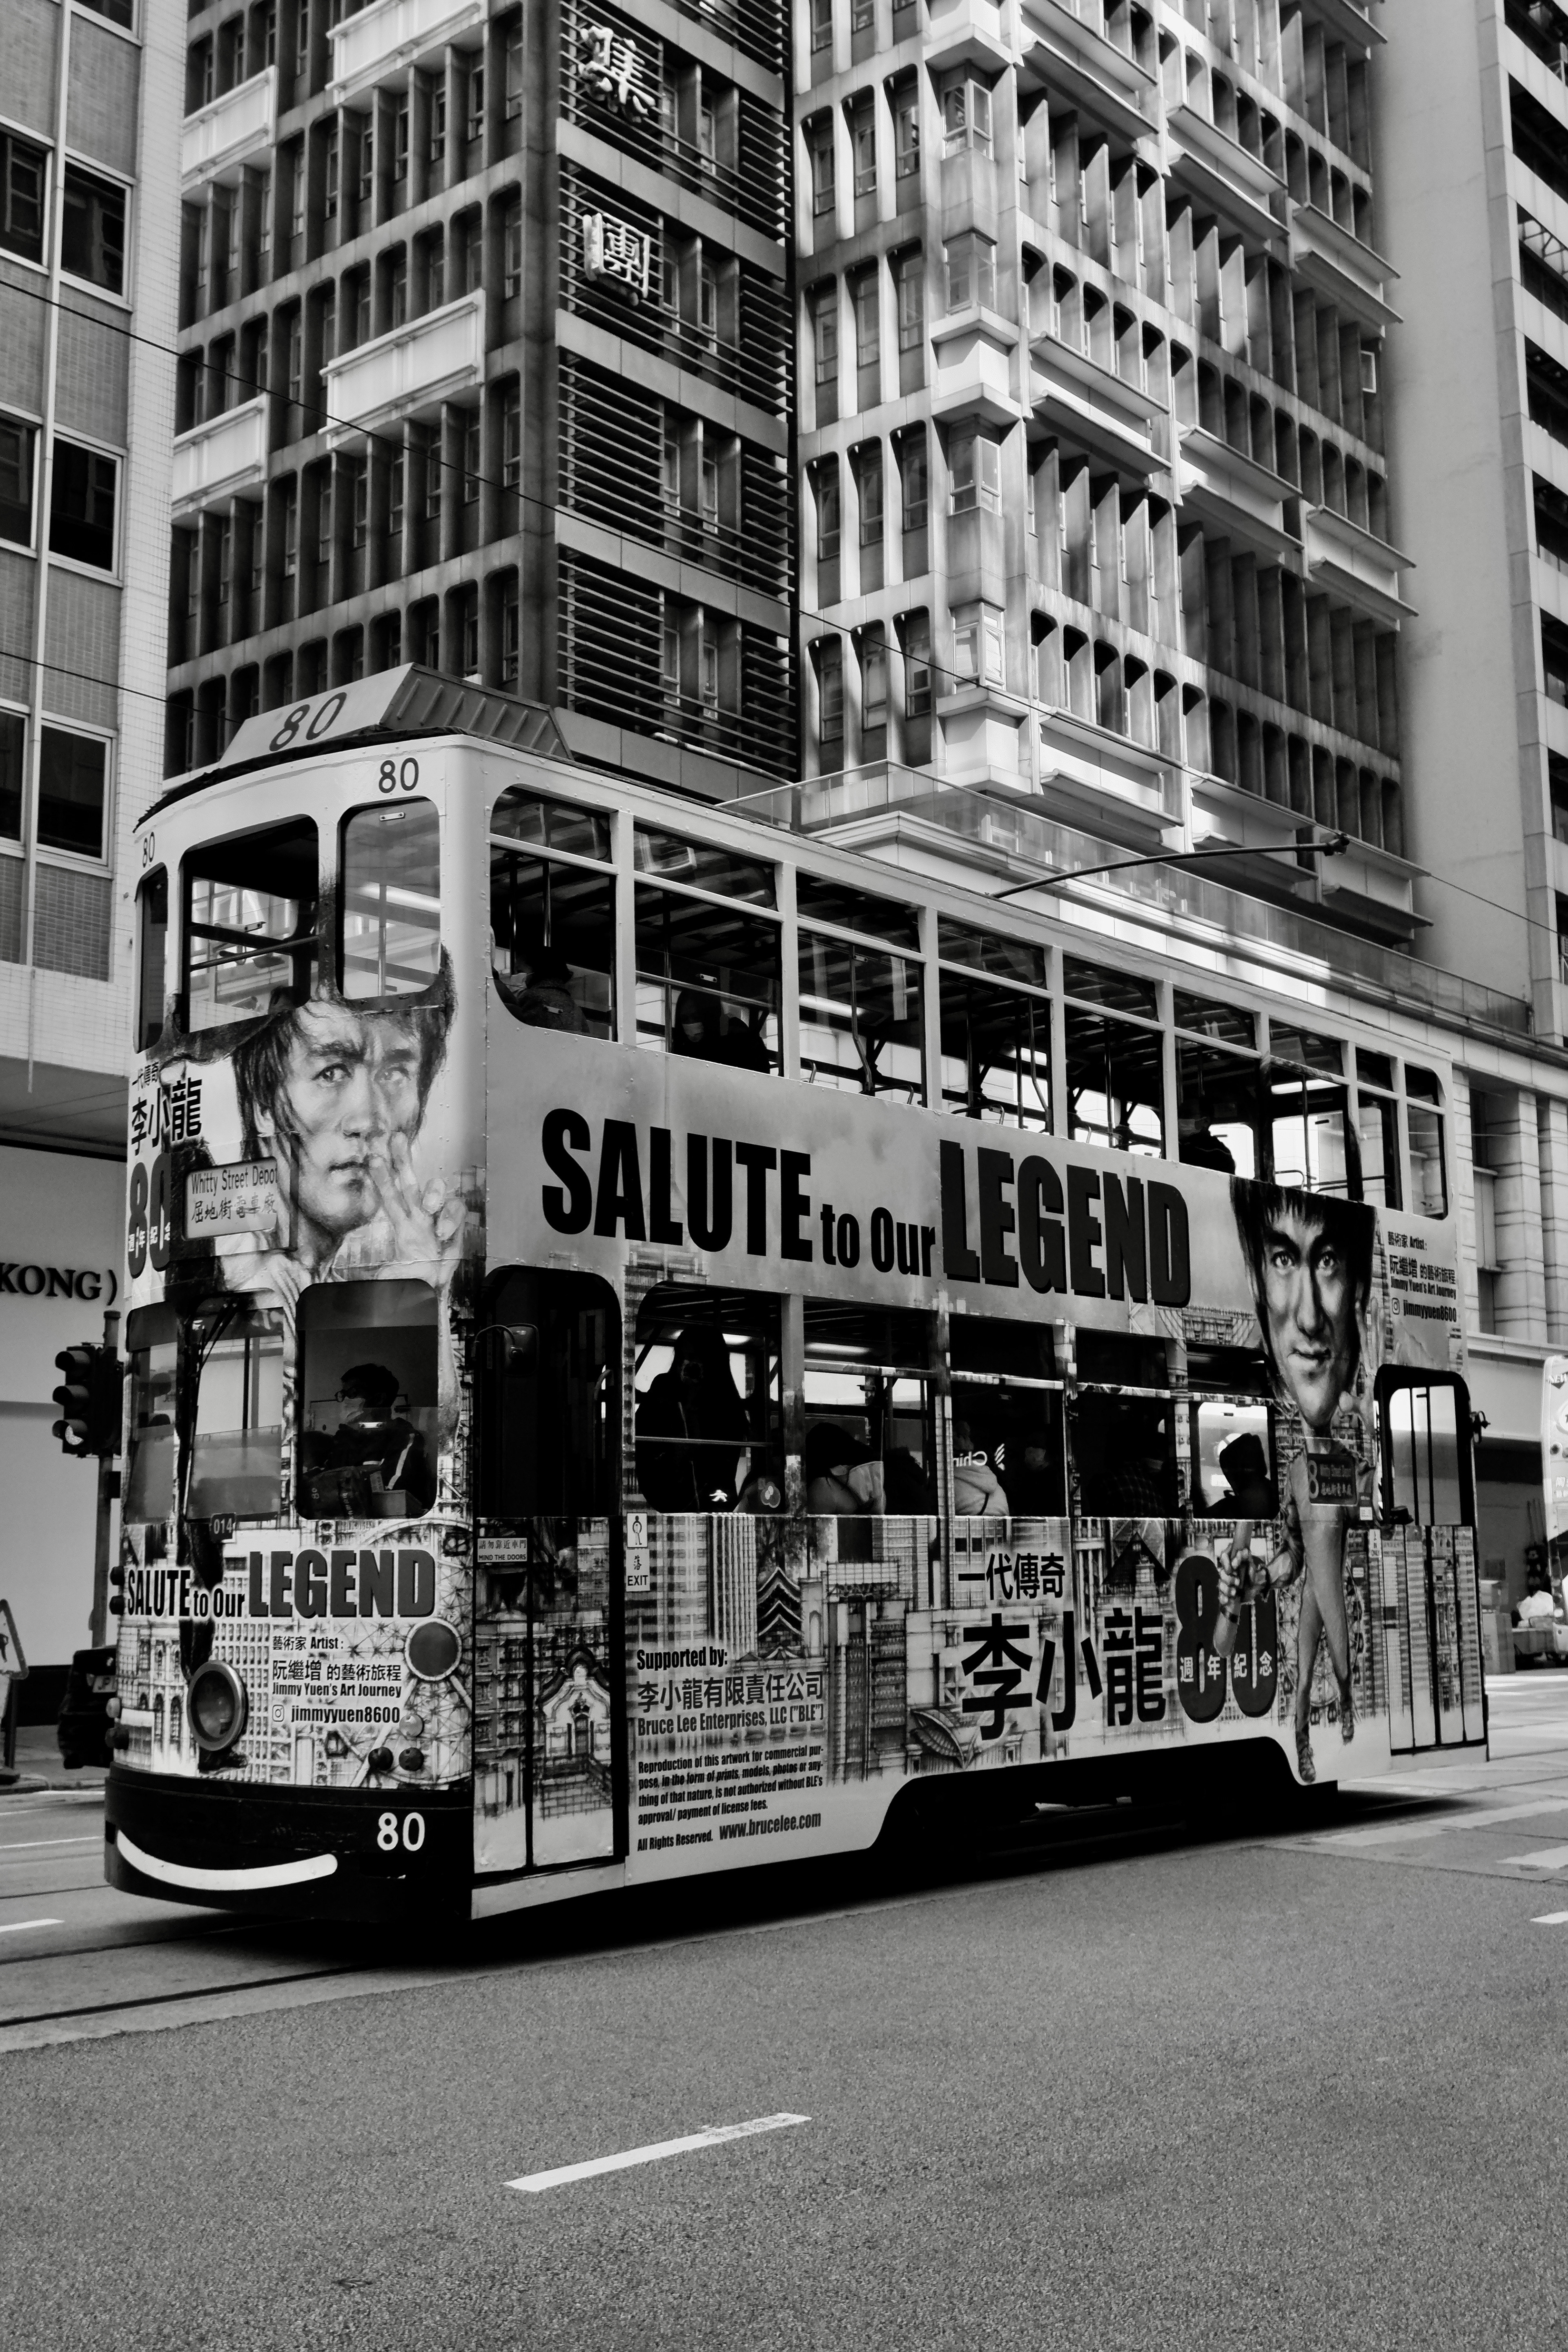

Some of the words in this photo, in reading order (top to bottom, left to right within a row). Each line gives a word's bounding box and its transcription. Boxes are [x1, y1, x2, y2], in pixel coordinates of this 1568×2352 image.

[269, 692, 347, 752] 80
[378, 757, 419, 793] 80
[142, 831, 155, 868] 80
[131, 1077, 203, 1156] 李小龍
[191, 1172, 218, 1196] Whitty
[221, 1167, 248, 1191] Street
[252, 1165, 278, 1188] Depot
[128, 1153, 172, 1279] 80
[542, 1108, 813, 1262] SALUTE
[820, 1203, 860, 1268] to
[871, 1207, 935, 1277] Our
[940, 1139, 1191, 1308] LEGEND
[1388, 1231, 1408, 1248] 藝術家
[1391, 1276, 1408, 1292] Jimmy
[1436, 1284, 1457, 1300] Journey
[1403, 1299, 1457, 1323] jimmyyuen8600
[213, 1518, 233, 1535] 014
[633, 1555, 641, 1570] 落
[958, 1552, 1066, 1601] 一代傳奇
[128, 1569, 191, 1617] SALUTE
[193, 1592, 209, 1618] to
[213, 1588, 245, 1618] Our
[248, 1549, 436, 1619] LEGEND
[627, 1575, 649, 1586] EXIT
[272, 1636, 307, 1651] 藝術家
[637, 1646, 706, 1671] Supported
[709, 1646, 728, 1668] by:
[272, 1660, 322, 1682] 阮繼增
[327, 1664, 402, 1682] 的藝術旅程
[961, 1607, 1167, 1741] 李小龍
[1179, 1650, 1273, 1684] 週年紀念
[272, 1682, 302, 1697] Jimmy
[304, 1683, 338, 1697] Yuen's
[340, 1683, 356, 1696] Art
[358, 1684, 402, 1699] Journey
[637, 1671, 823, 1714] 李小龍有限責任公司
[291, 1706, 400, 1724] jimmyyuen8600
[638, 1716, 674, 1736] Bruce
[677, 1713, 697, 1733] Lee
[700, 1710, 768, 1731] Enterprises,
[770, 1705, 786, 1725] LLC
[638, 1757, 693, 1775] Reproduction
[695, 1755, 702, 1767] of
[704, 1754, 719, 1766] this
[721, 1751, 750, 1765] artwork
[752, 1750, 762, 1762] for
[764, 1745, 807, 1761] commercial
[809, 1745, 824, 1757] pur-
[638, 1775, 660, 1791] pose,
[662, 1775, 670, 1787] in
[672, 1774, 684, 1786] the
[686, 1772, 705, 1784] form
[706, 1770, 715, 1782] of
[716, 1769, 740, 1783] prints,
[742, 1764, 771, 1778] models,
[773, 1762, 797, 1777] photos
[799, 1763, 807, 1772] or
[808, 1759, 824, 1772] any-
[638, 1794, 659, 1808] thing
[660, 1792, 668, 1804] of
[670, 1790, 685, 1803] that
[687, 1788, 714, 1802] nature,
[715, 1786, 722, 1798] is
[724, 1785, 736, 1797] not
[737, 1780, 777, 1795] authorized
[778, 1777, 805, 1791] without
[806, 1775, 823, 1788] BLE's
[638, 1808, 676, 1825] approval/
[677, 1804, 711, 1821] payment
[712, 1803, 720, 1816] of
[721, 1801, 749, 1815] license
[750, 1798, 768, 1811] fees.
[376, 1811, 426, 1852] 80
[637, 1838, 648, 1852] All
[649, 1835, 674, 1851] Rights
[676, 1829, 713, 1846] Reserved.
[719, 1812, 822, 1840] www.brucelee.com
